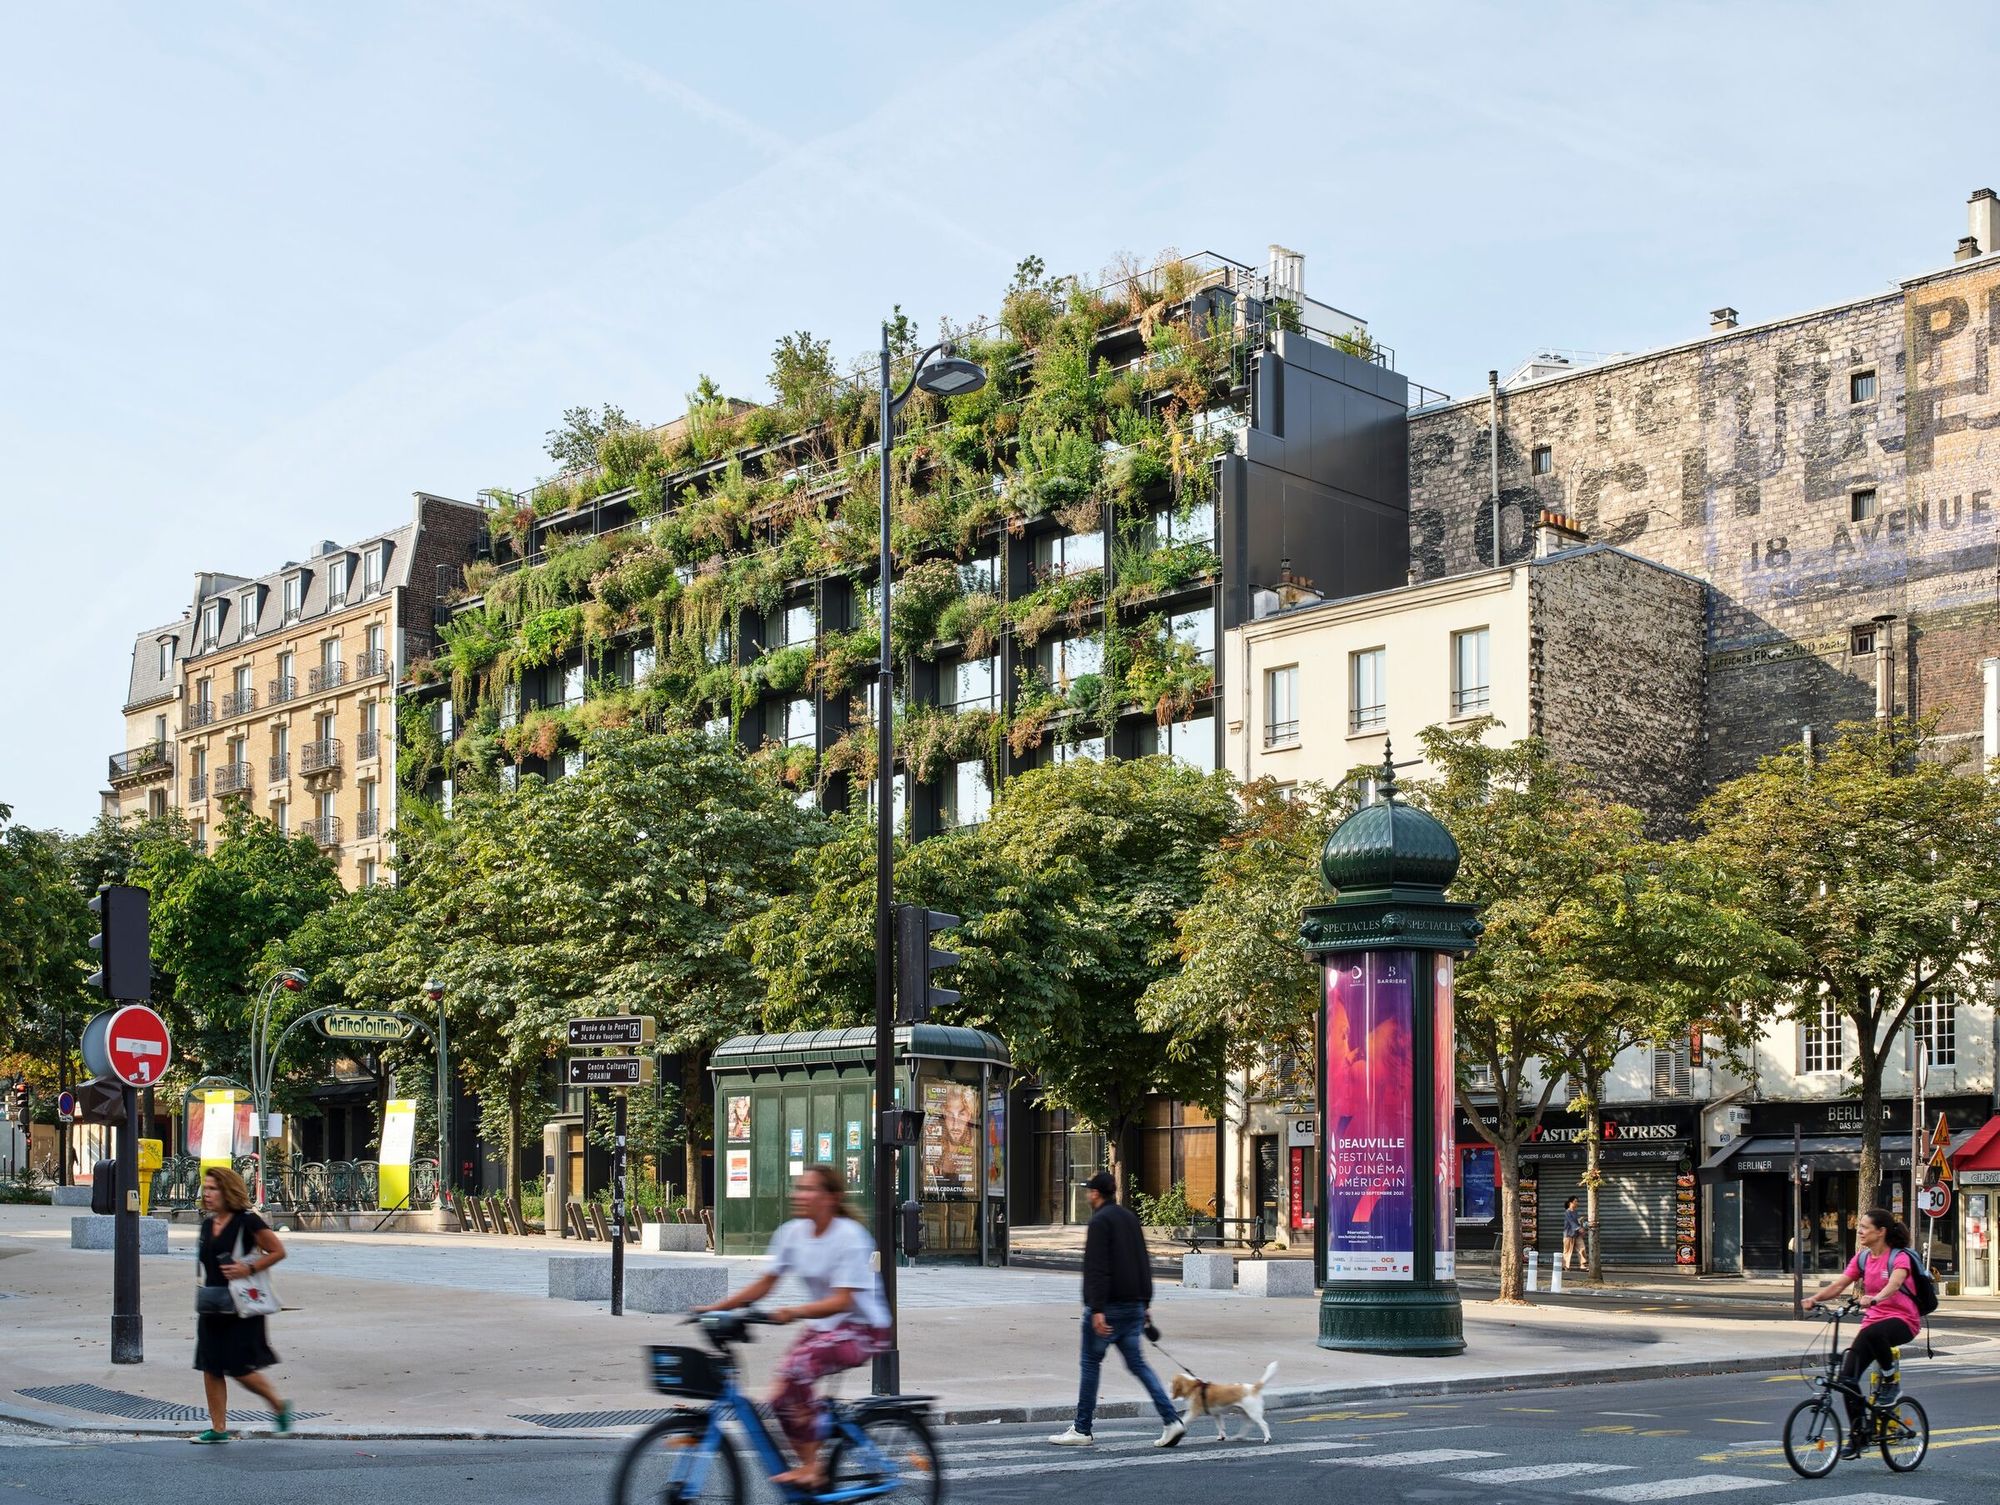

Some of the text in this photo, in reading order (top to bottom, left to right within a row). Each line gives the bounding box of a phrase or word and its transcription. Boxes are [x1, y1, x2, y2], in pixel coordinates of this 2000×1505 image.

[1750, 489, 1993, 572] 18 AVENUE
[1714, 653, 1755, 668] AFFICHES
[1323, 919, 1461, 933] SPECTACLES SPECTACLES
[330, 1016, 400, 1036] METROPOLITAIN
[581, 1024, 598, 1032] Musée
[607, 1023, 613, 1031] la
[587, 1062, 628, 1071] Centre Culturel
[587, 1072, 611, 1080] FORANIM
[1828, 1105, 1891, 1121] BERLIR
[1603, 1121, 1677, 1140] EXPRESS
[1840, 1122, 1852, 1130] DAS
[1339, 1138, 1405, 1149] DEAUVILLE
[1339, 1152, 1392, 1162] FESTIVAL
[1339, 1163, 1405, 1175] DU CINÉMA
[1737, 1160, 1772, 1170] BERLINER
[1339, 1176, 1405, 1188] AMÉRICAIN
[1930, 1190, 1945, 1207] 30
